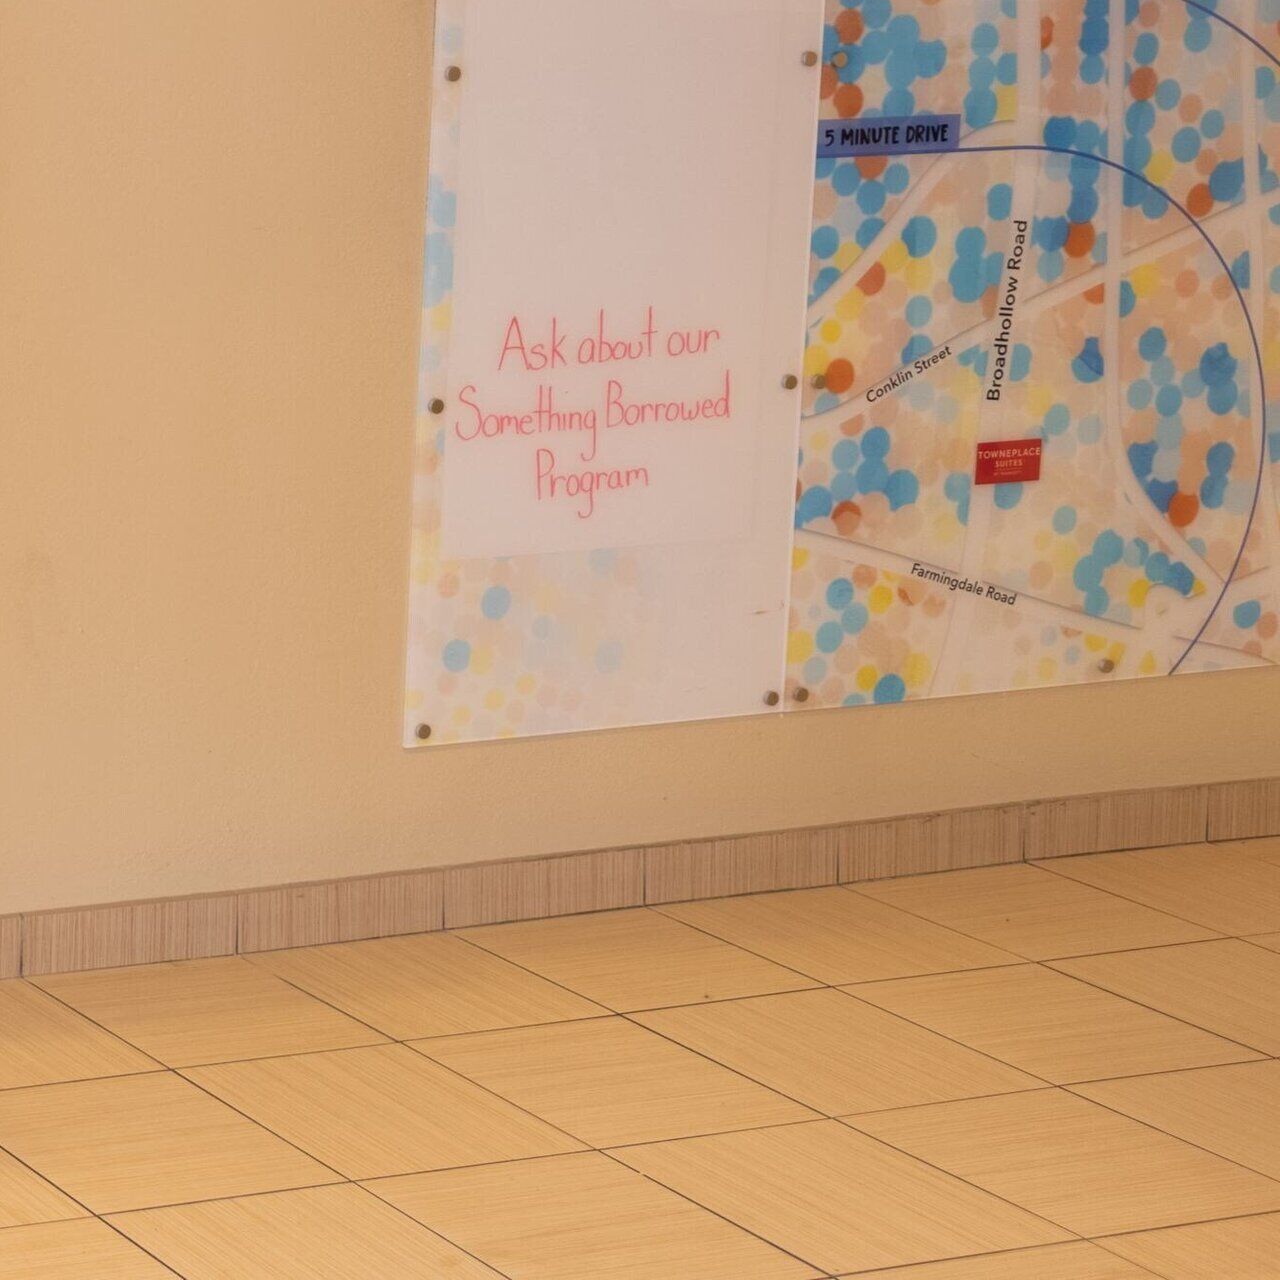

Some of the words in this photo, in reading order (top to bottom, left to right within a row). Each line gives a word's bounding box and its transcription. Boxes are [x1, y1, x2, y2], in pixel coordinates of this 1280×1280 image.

[824, 129, 835, 147] 5
[840, 126, 900, 146] MINUTE
[905, 123, 949, 144] DRIVE
[498, 316, 568, 372] Ask
[577, 306, 658, 364] about
[667, 328, 721, 357] our
[986, 276, 1020, 402] Broadhollow
[1007, 220, 1028, 271] Road
[865, 369, 912, 404] Conklin
[914, 345, 953, 375] Street
[455, 384, 597, 461] Something
[606, 370, 731, 429] Borrowed
[978, 447, 1041, 460] TOWNEPLACE
[995, 459, 1023, 468] SUITES
[535, 448, 649, 519] Program
[910, 563, 984, 596] Farmingdale
[985, 581, 1018, 606] Road
